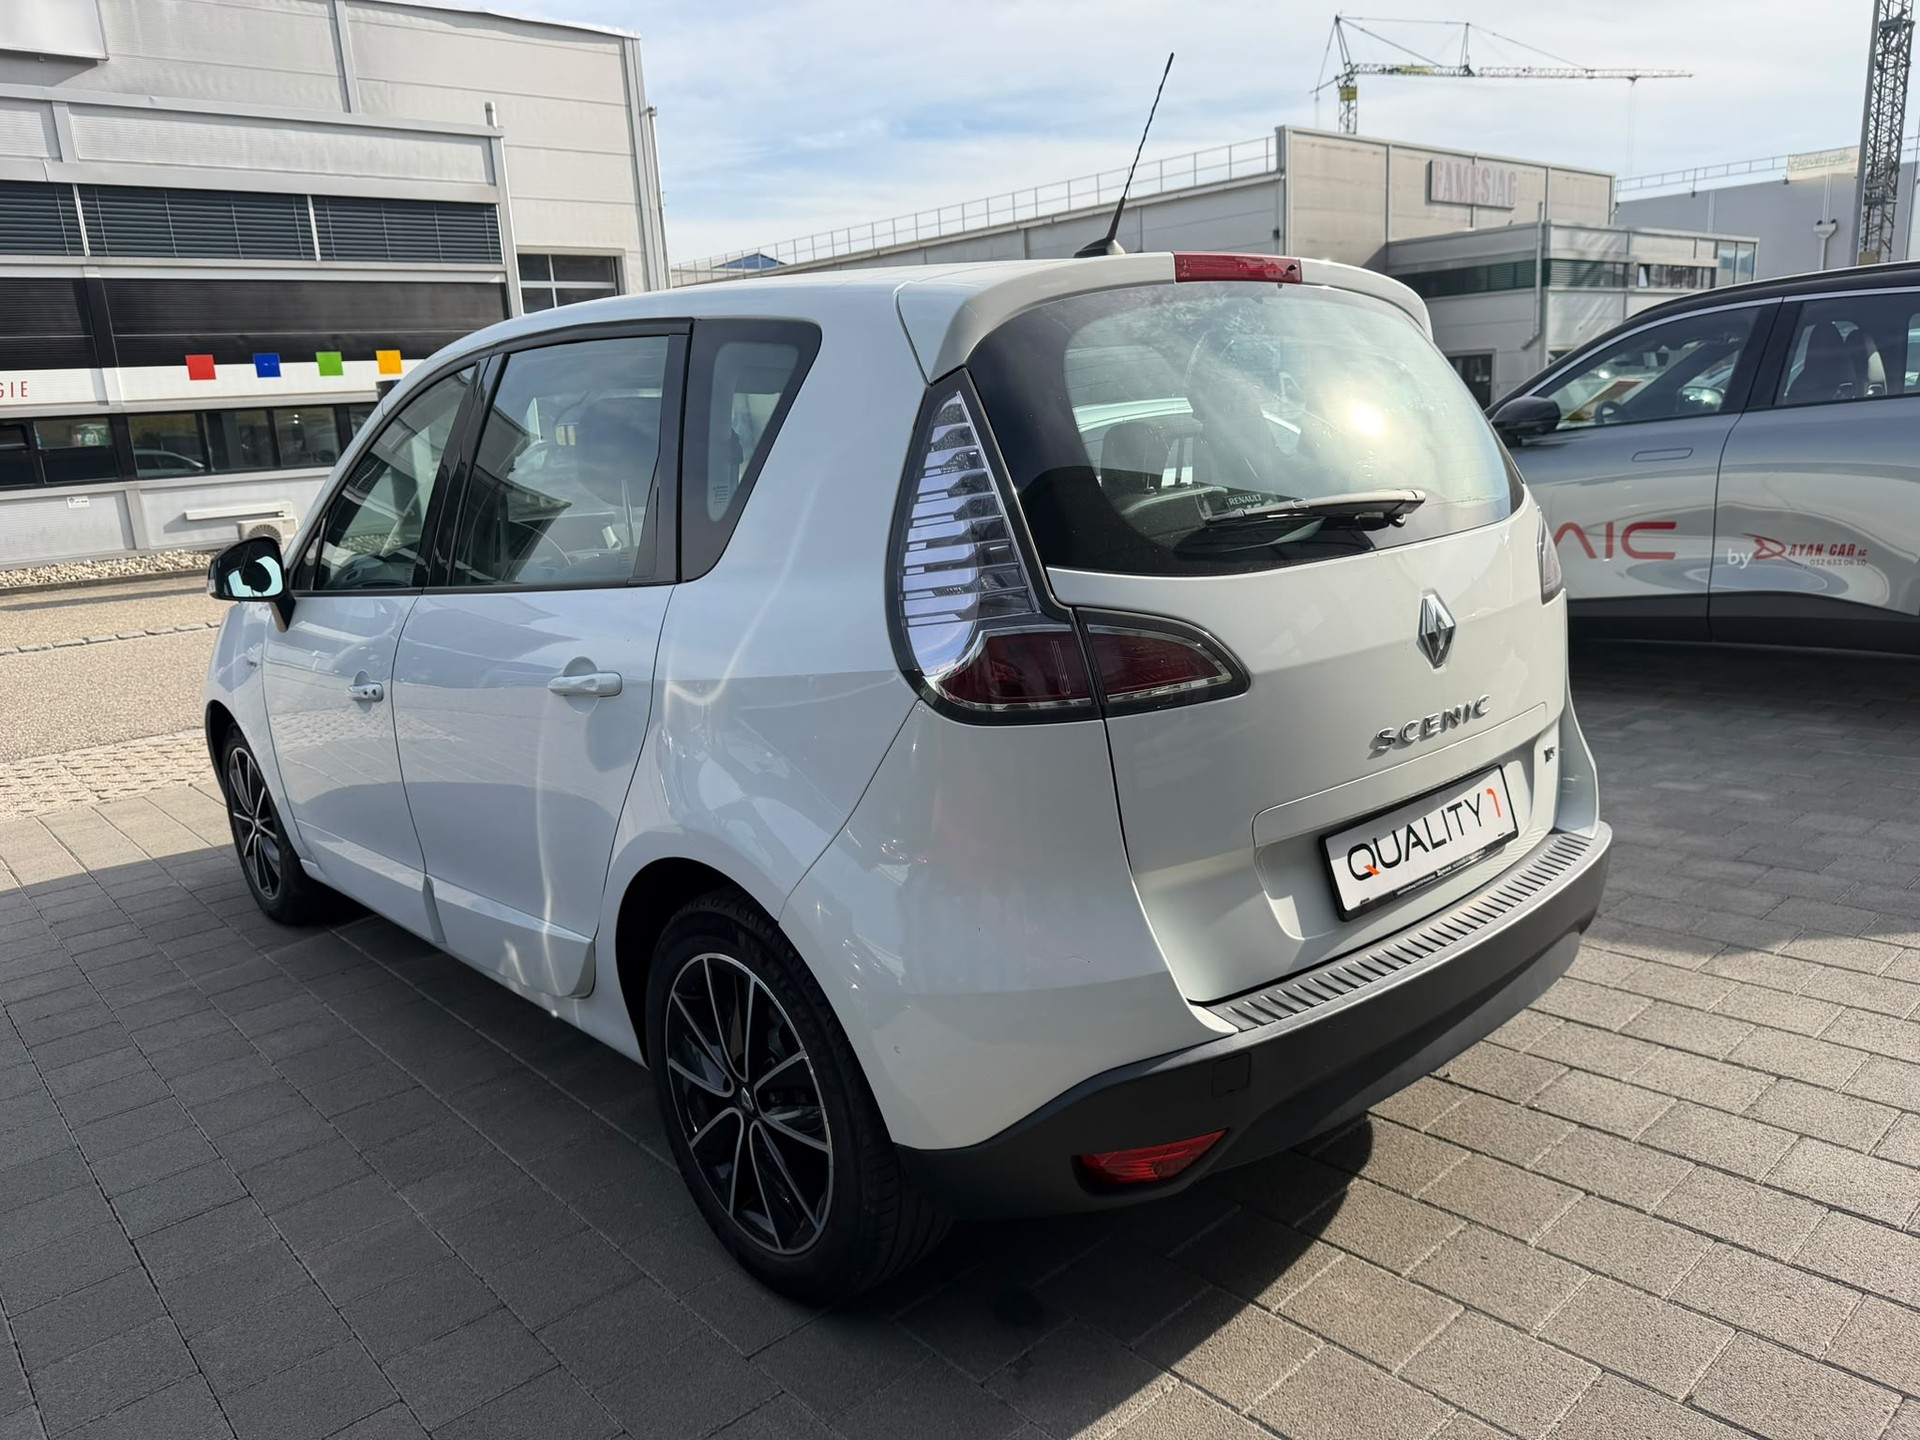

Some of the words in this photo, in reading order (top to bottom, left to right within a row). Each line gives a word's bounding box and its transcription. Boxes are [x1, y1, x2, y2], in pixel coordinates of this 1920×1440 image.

[1228, 494, 1262, 506] RENAULT
[1727, 548, 1752, 569] by
[1829, 543, 1857, 557] CAR
[1373, 694, 1490, 751] SCENIC
